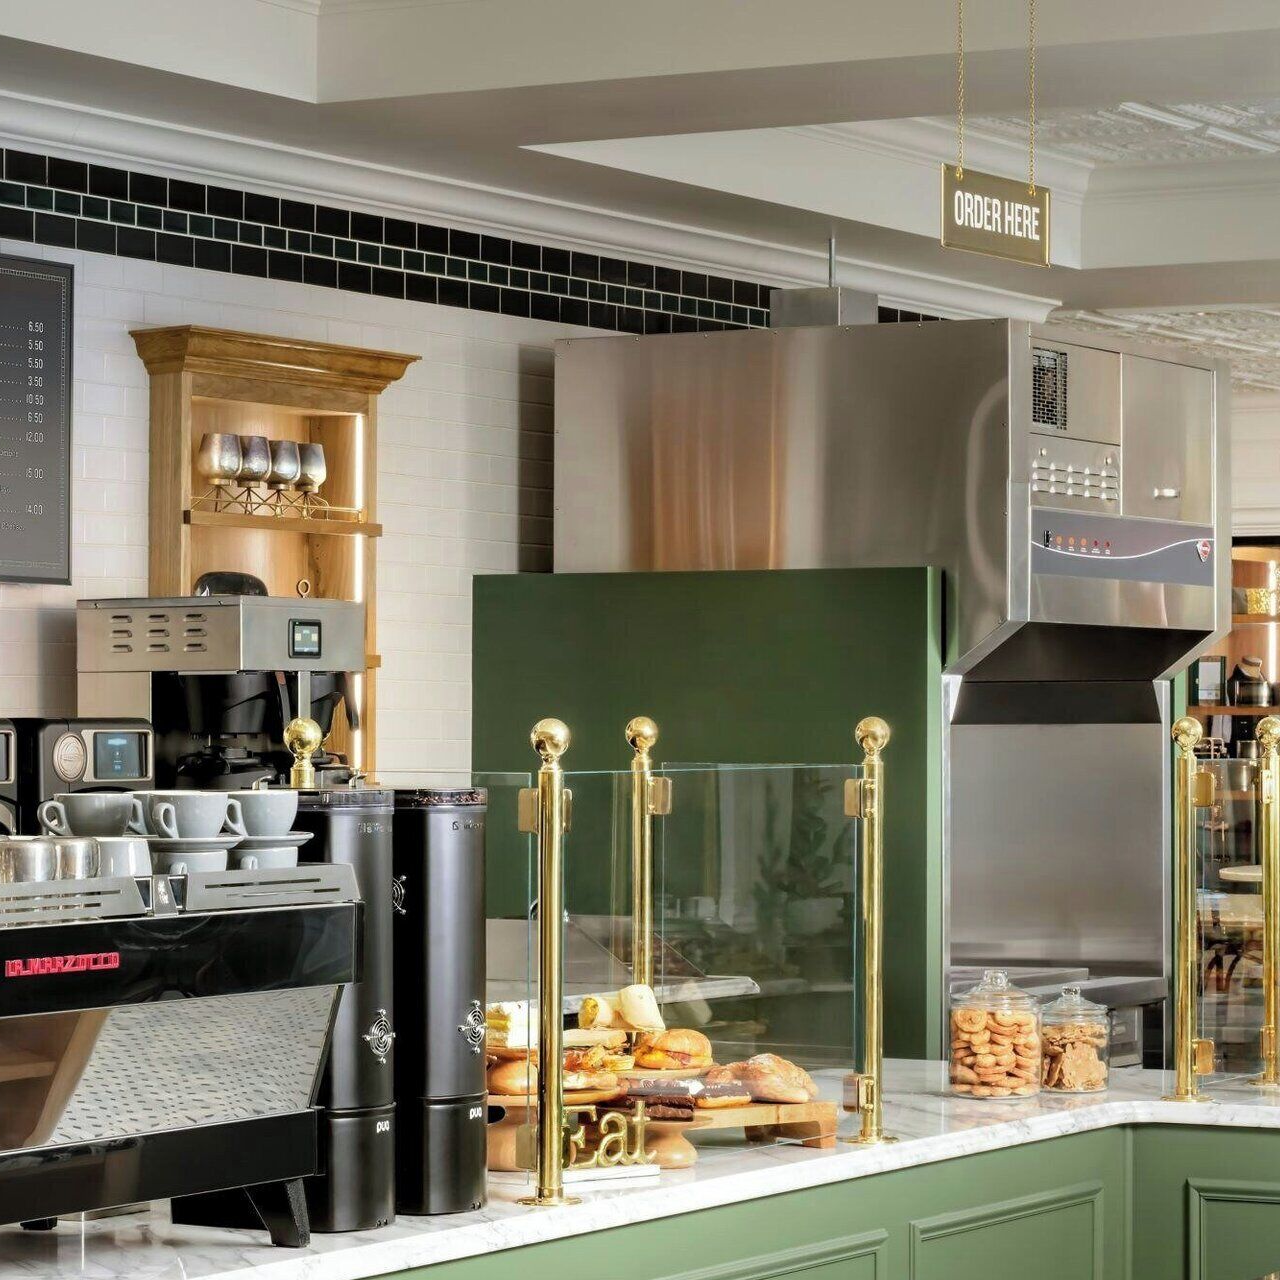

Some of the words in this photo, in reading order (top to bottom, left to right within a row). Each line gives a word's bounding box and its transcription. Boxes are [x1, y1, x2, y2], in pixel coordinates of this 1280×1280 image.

[954, 190, 1001, 233] ORDER
[1004, 201, 1040, 241] HERE
[562, 1100, 657, 1168] Eat
